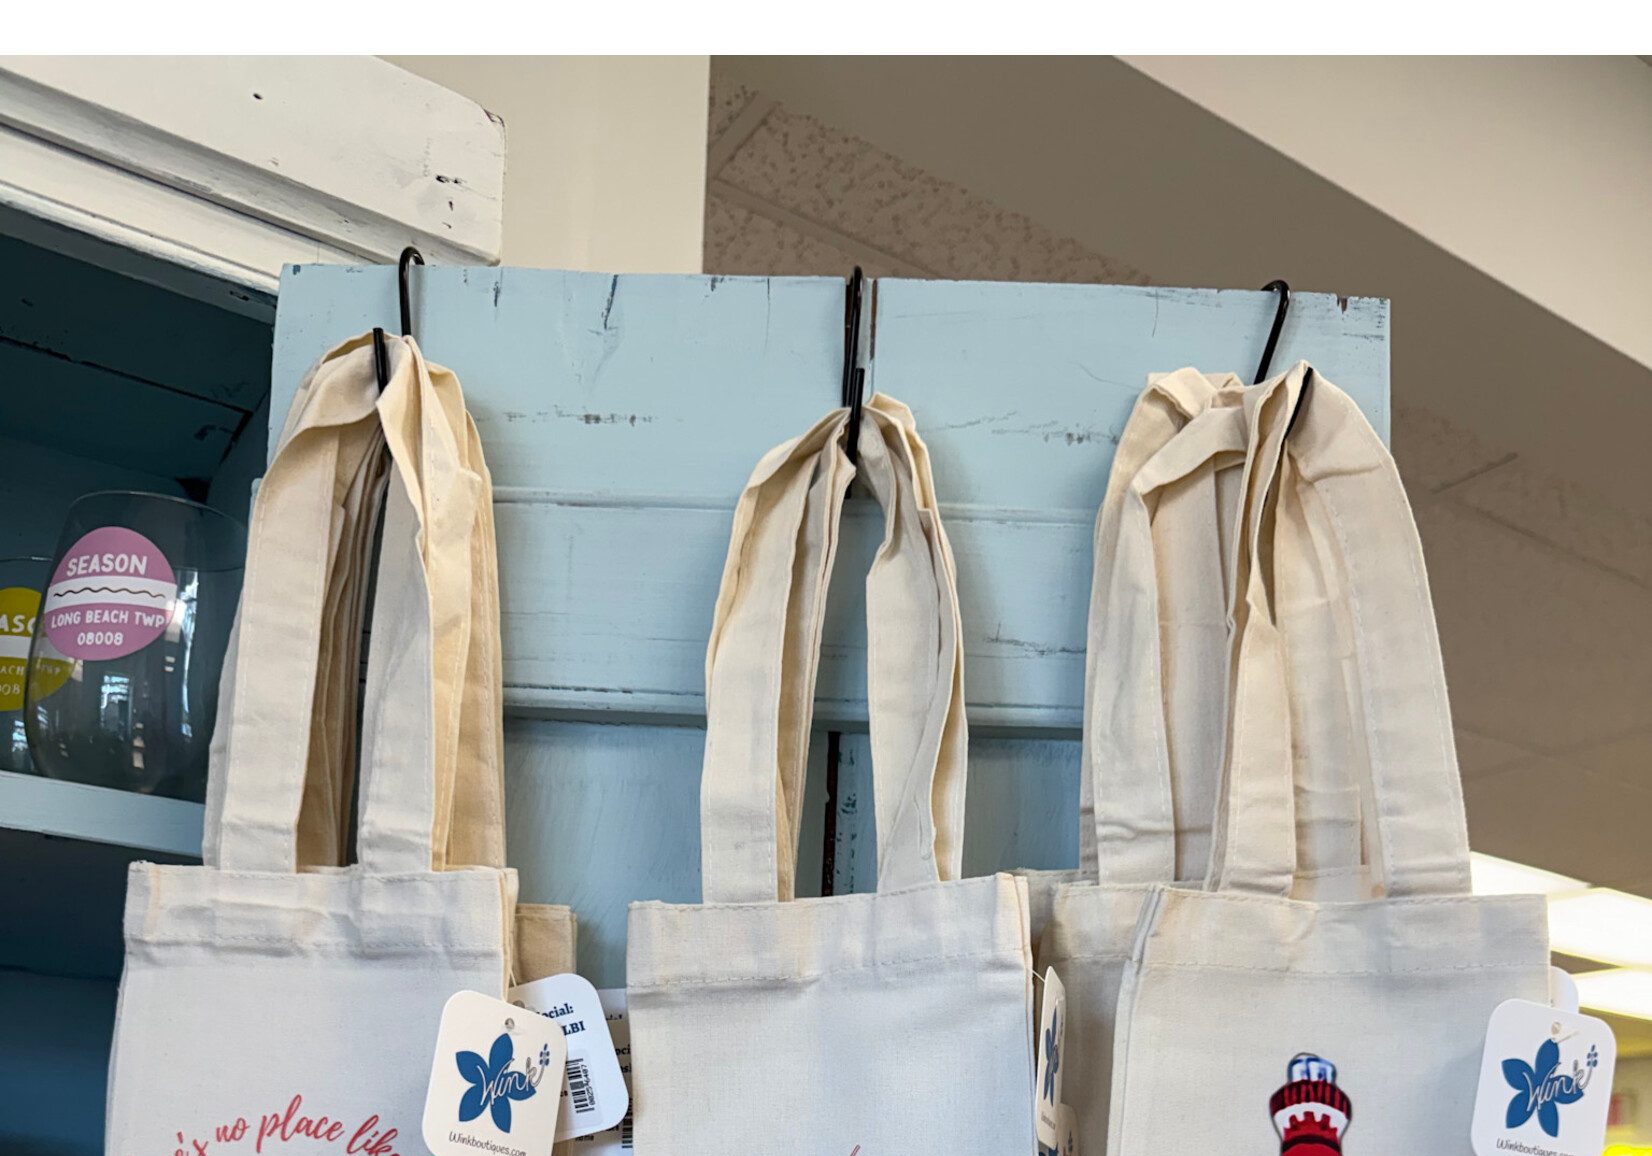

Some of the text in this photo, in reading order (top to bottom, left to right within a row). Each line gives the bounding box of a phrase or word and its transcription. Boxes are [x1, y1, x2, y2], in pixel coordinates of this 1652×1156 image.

[66, 554, 147, 576] SEASON
[51, 609, 165, 628] LONG BEACH TWP
[77, 632, 124, 646] 08008
[477, 1056, 545, 1107] Wink
[1523, 1059, 1594, 1112] Wink
[215, 1111, 249, 1142] no
[254, 1094, 345, 1153] place
